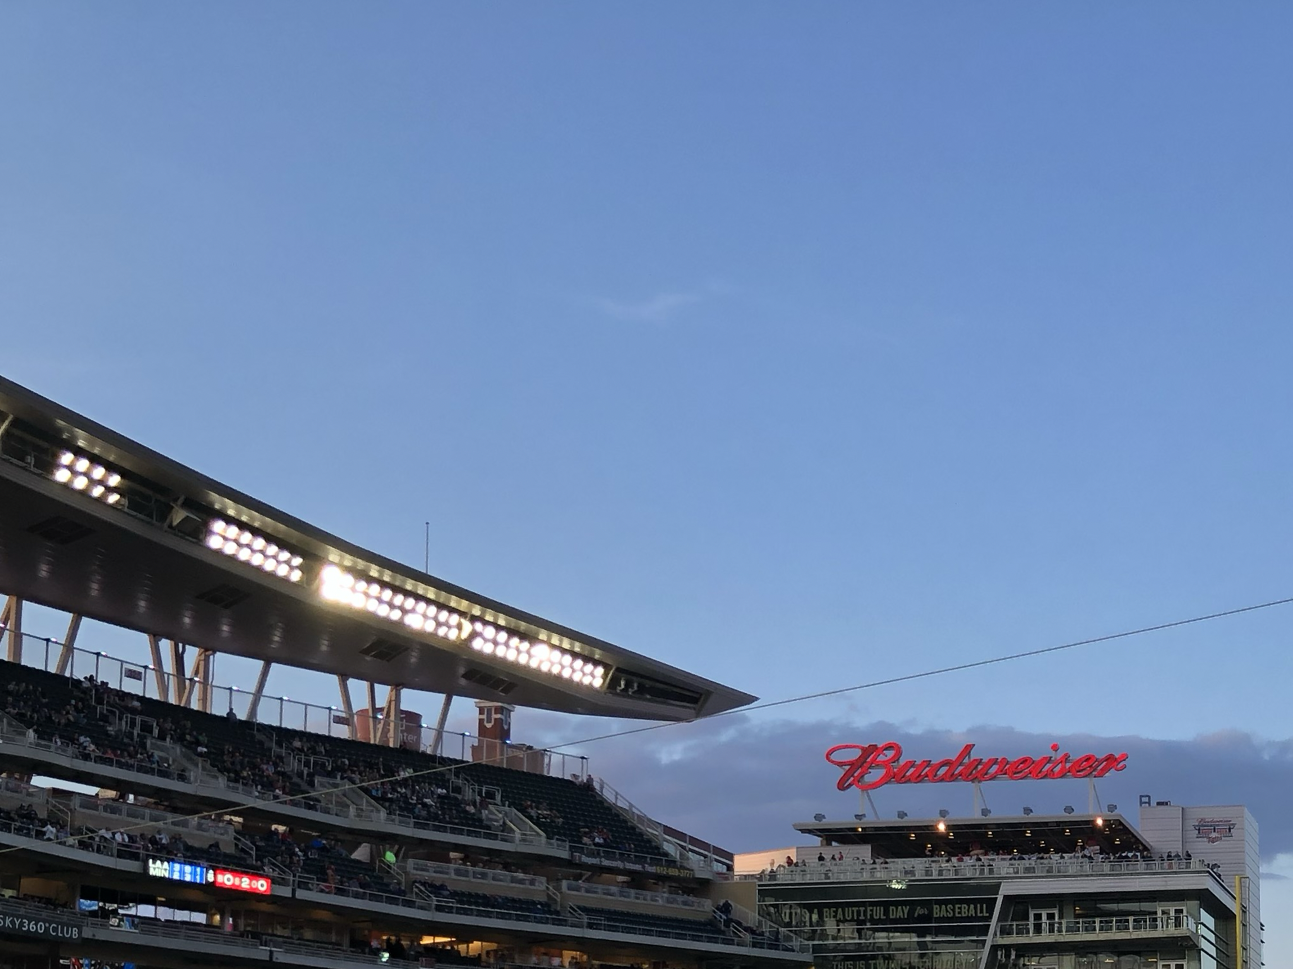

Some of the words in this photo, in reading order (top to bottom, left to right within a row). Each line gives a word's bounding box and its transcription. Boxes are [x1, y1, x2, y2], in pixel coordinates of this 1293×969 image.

[825, 741, 1129, 791] Budweiser
[823, 905, 886, 920] BEAUTIFUL
[889, 905, 909, 919] DAY
[933, 903, 989, 917] BASEBALL
